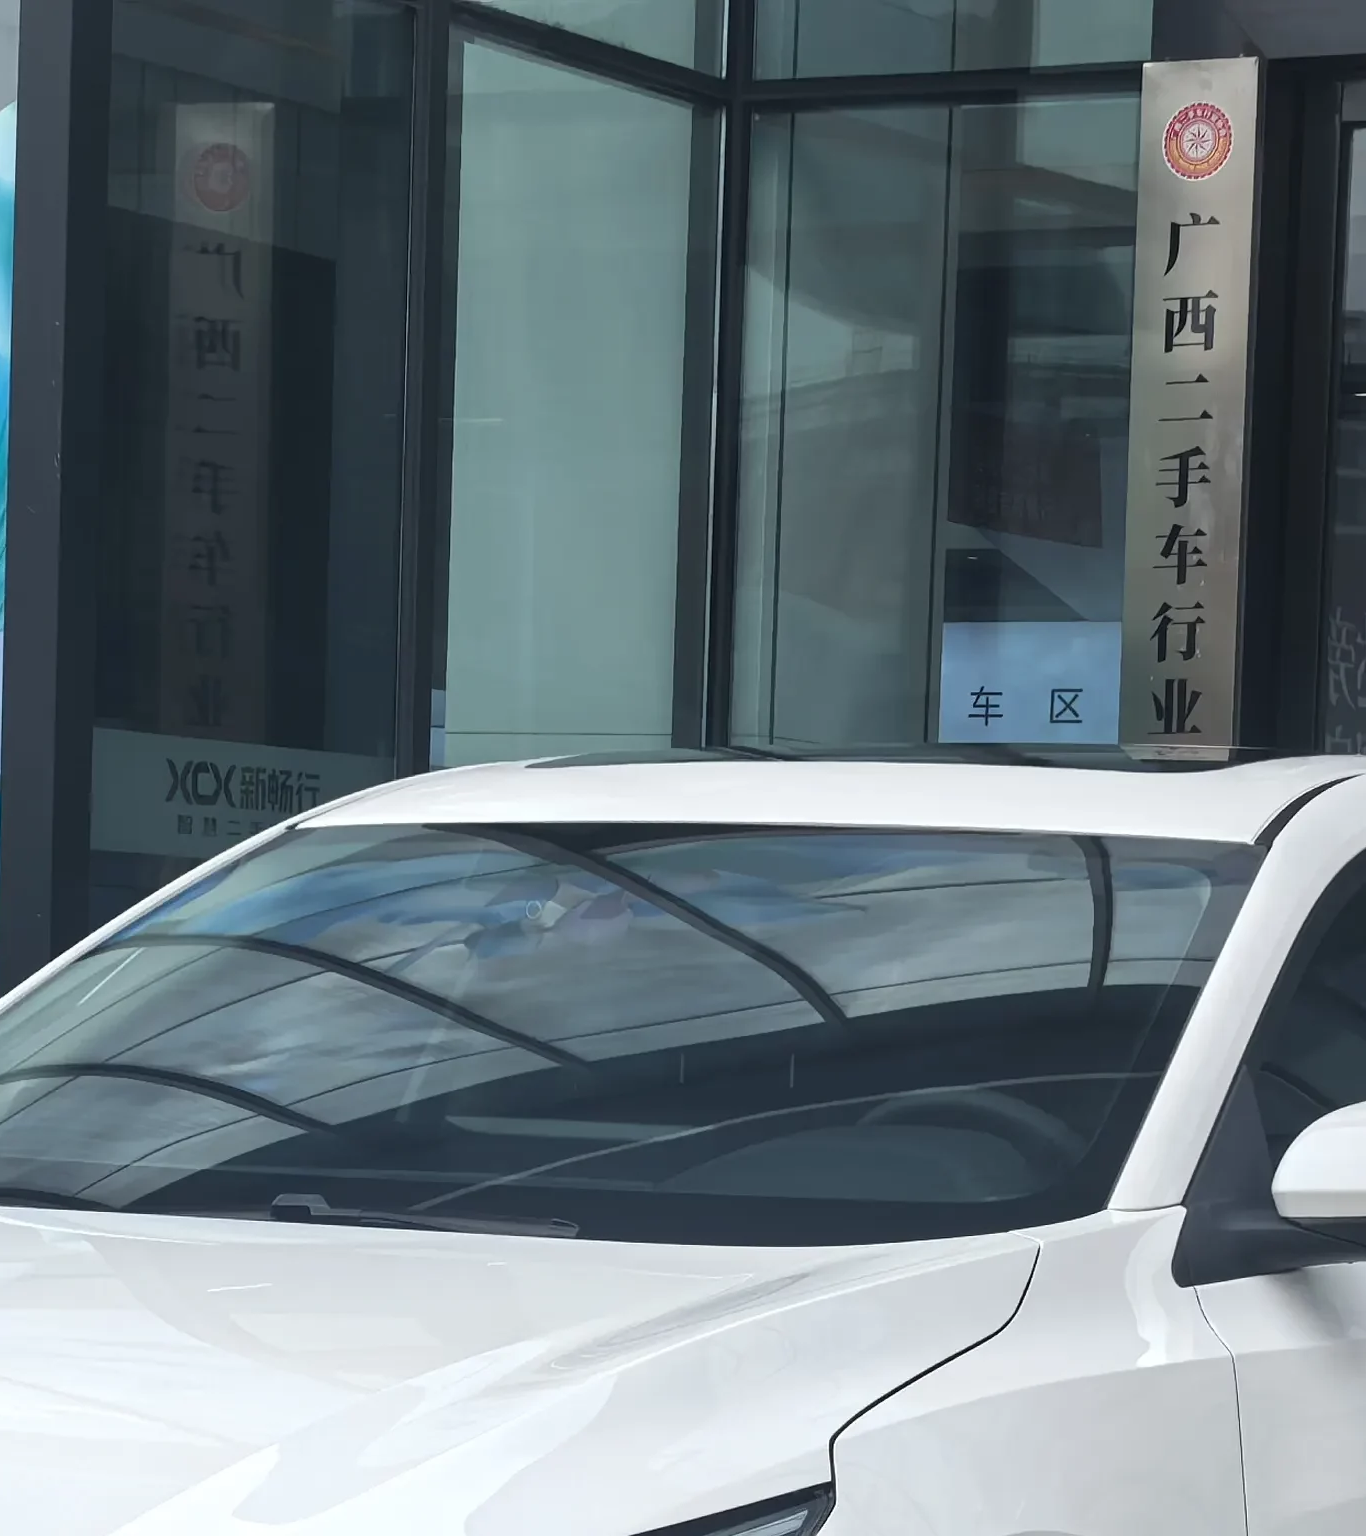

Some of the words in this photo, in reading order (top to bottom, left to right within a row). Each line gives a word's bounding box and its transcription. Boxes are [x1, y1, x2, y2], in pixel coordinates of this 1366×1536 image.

[1147, 212, 1221, 736] 广西二手车行业
